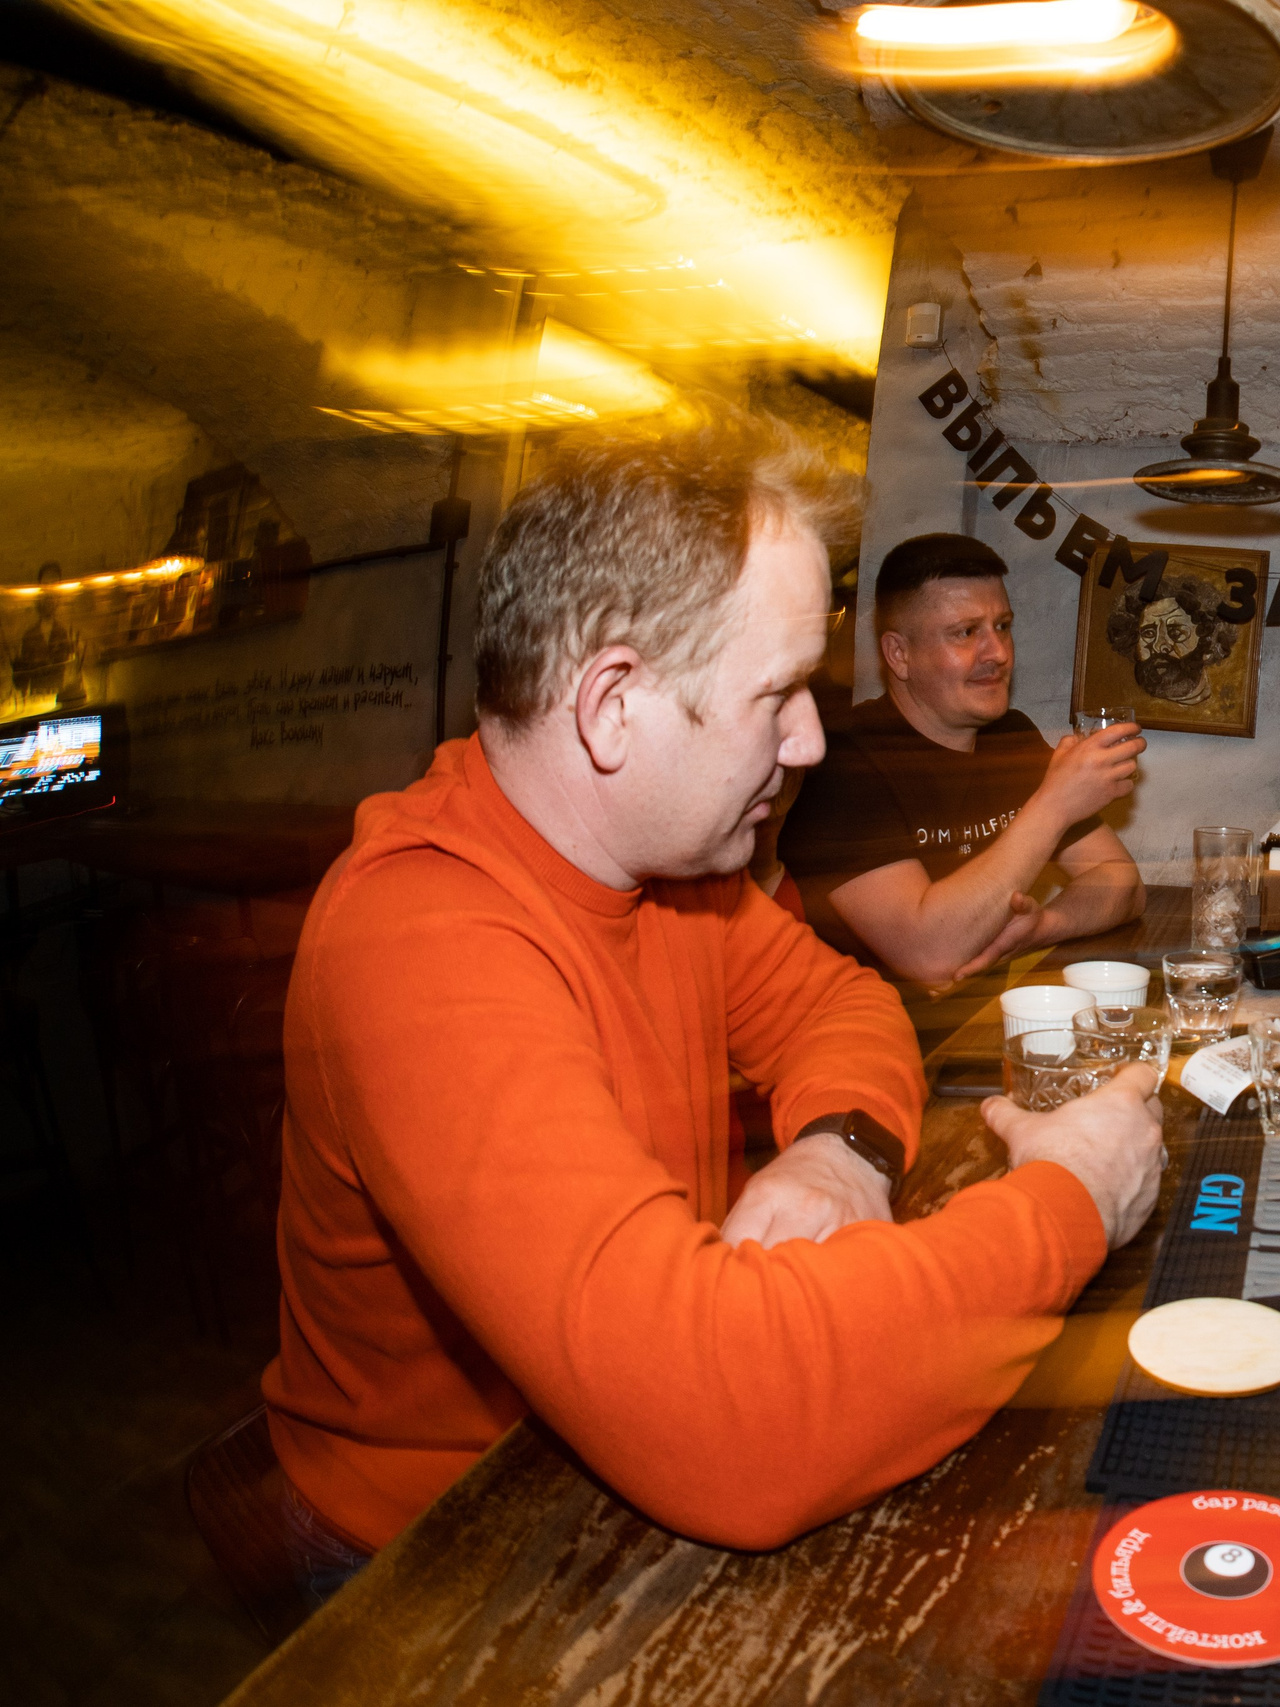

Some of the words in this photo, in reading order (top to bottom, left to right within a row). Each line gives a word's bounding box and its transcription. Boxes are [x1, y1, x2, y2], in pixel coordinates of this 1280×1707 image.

[918, 367, 1169, 602] ВЫПЬЕМ
[1189, 1173, 1245, 1235] GIN
[1191, 1495, 1238, 1511] бар
[1107, 1528, 1153, 1600] бильярд
[1220, 1547, 1244, 1565] 8
[1121, 1598, 1147, 1617] &
[1137, 1610, 1267, 1650] коктейли
